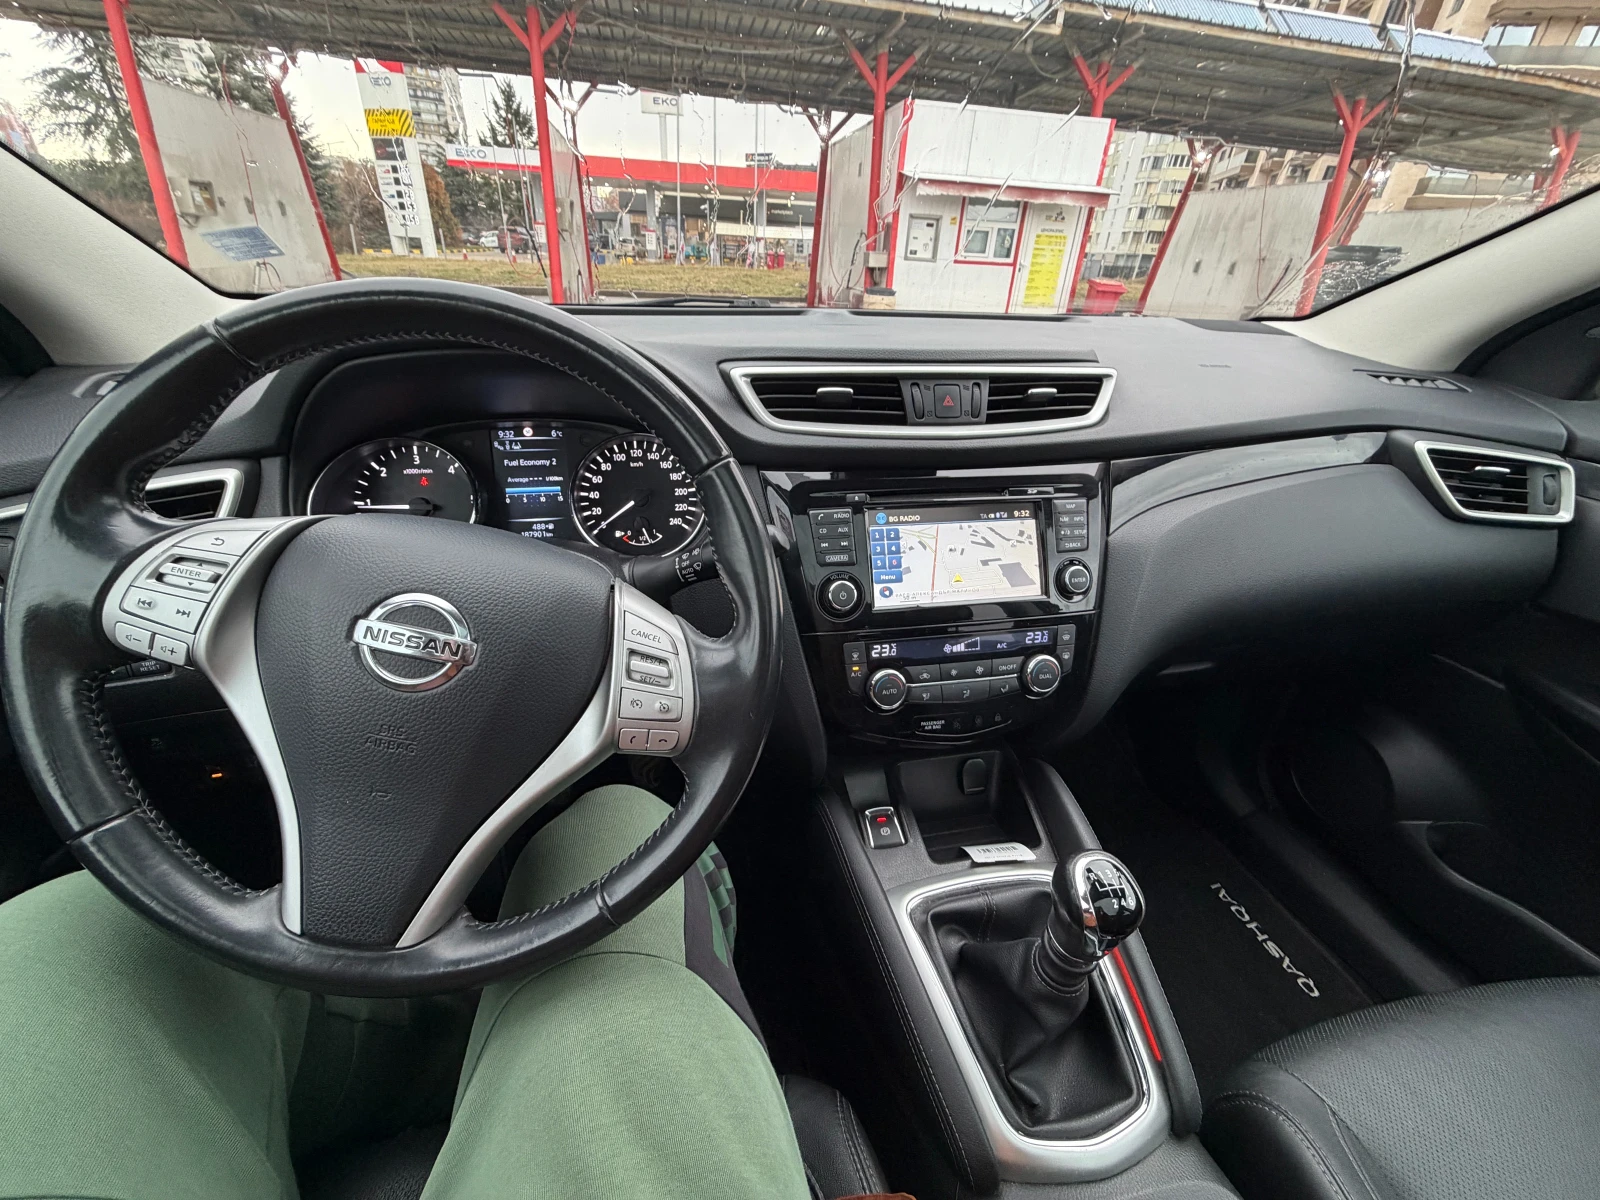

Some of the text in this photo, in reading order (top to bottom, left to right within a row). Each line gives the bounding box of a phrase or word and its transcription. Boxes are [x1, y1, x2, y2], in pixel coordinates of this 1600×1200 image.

[653, 97, 679, 106] EKO
[455, 147, 487, 159] EKO
[498, 430, 514, 438] 9:32
[413, 455, 420, 464] 3
[613, 453, 626, 461] 100
[504, 459, 518, 467] Fuel
[520, 459, 550, 467] Economy
[601, 463, 611, 471] 80
[660, 461, 672, 469] 160
[380, 468, 387, 477] 2
[448, 466, 455, 474] 4
[592, 475, 603, 483] 60
[589, 491, 599, 499] 40
[592, 507, 602, 515] 20
[171, 566, 202, 578] ENTER
[631, 628, 662, 644] CANCEL
[363, 625, 462, 659] NISSAN
[364, 735, 417, 756] AIRBAG
[1105, 869, 1112, 877] 3
[1112, 897, 1133, 908] 2 4 6
[1210, 882, 1320, 997] QASHQAI
